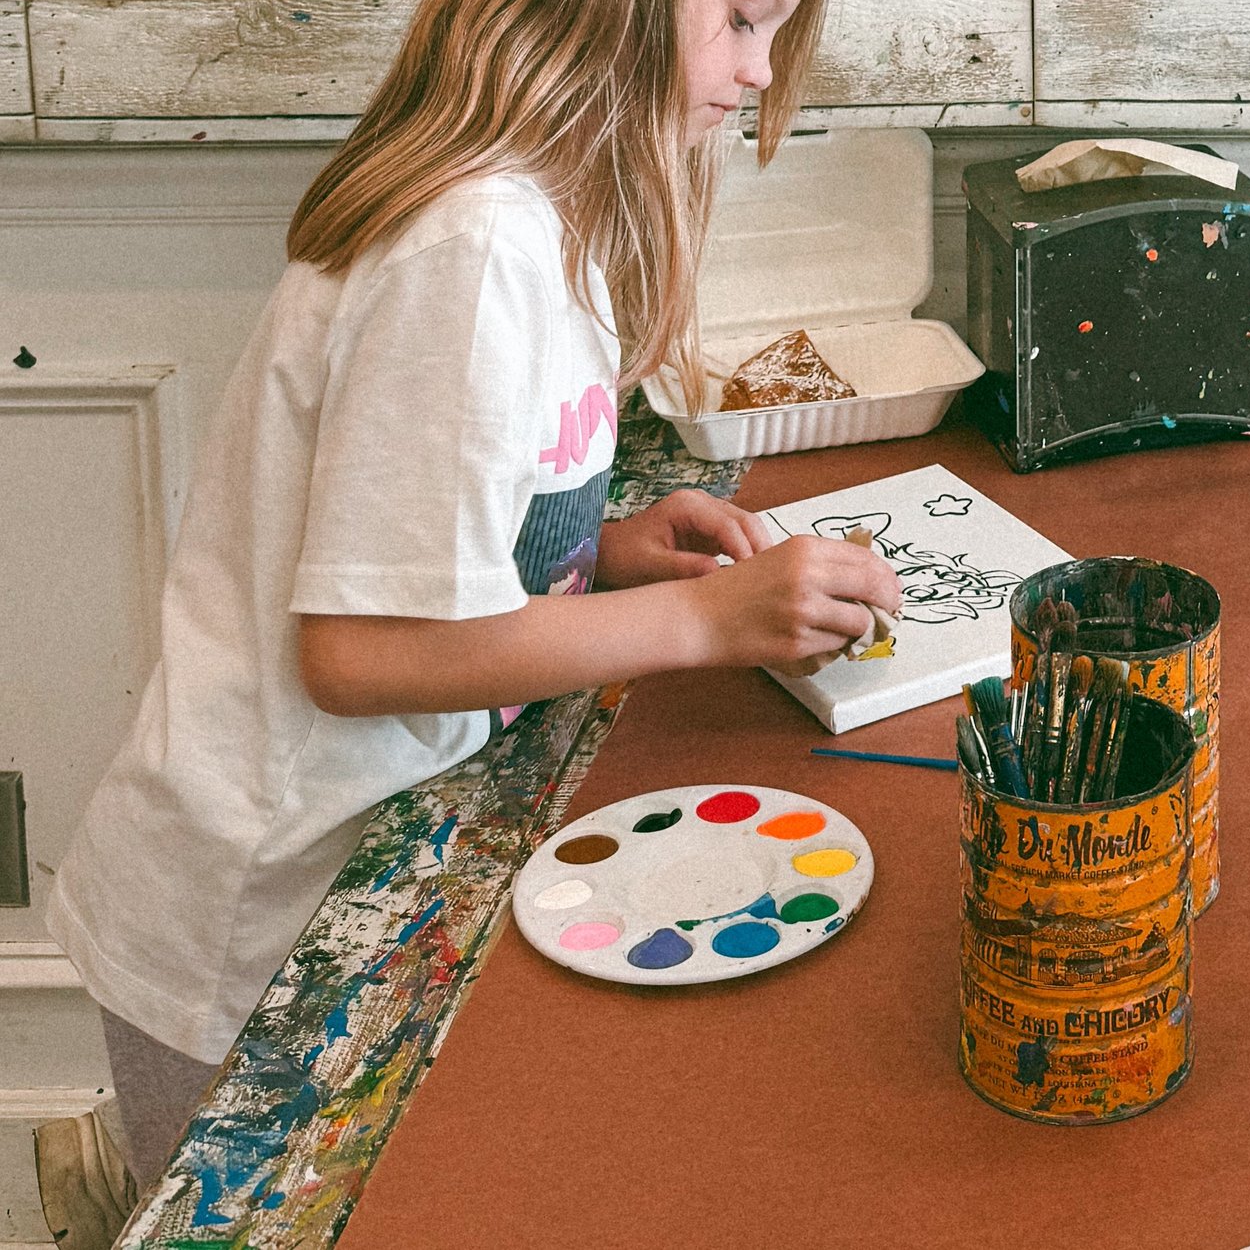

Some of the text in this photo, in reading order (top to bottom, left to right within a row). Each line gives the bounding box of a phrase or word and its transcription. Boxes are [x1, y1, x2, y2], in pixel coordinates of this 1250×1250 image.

[1017, 815, 1056, 863] Du
[1060, 813, 1151, 868] Monde
[1045, 868, 1081, 881] MARKET
[1084, 866, 1117, 880] COFFEE
[1021, 1014, 1059, 1036] AND
[1064, 986, 1171, 1038] CHICORY
